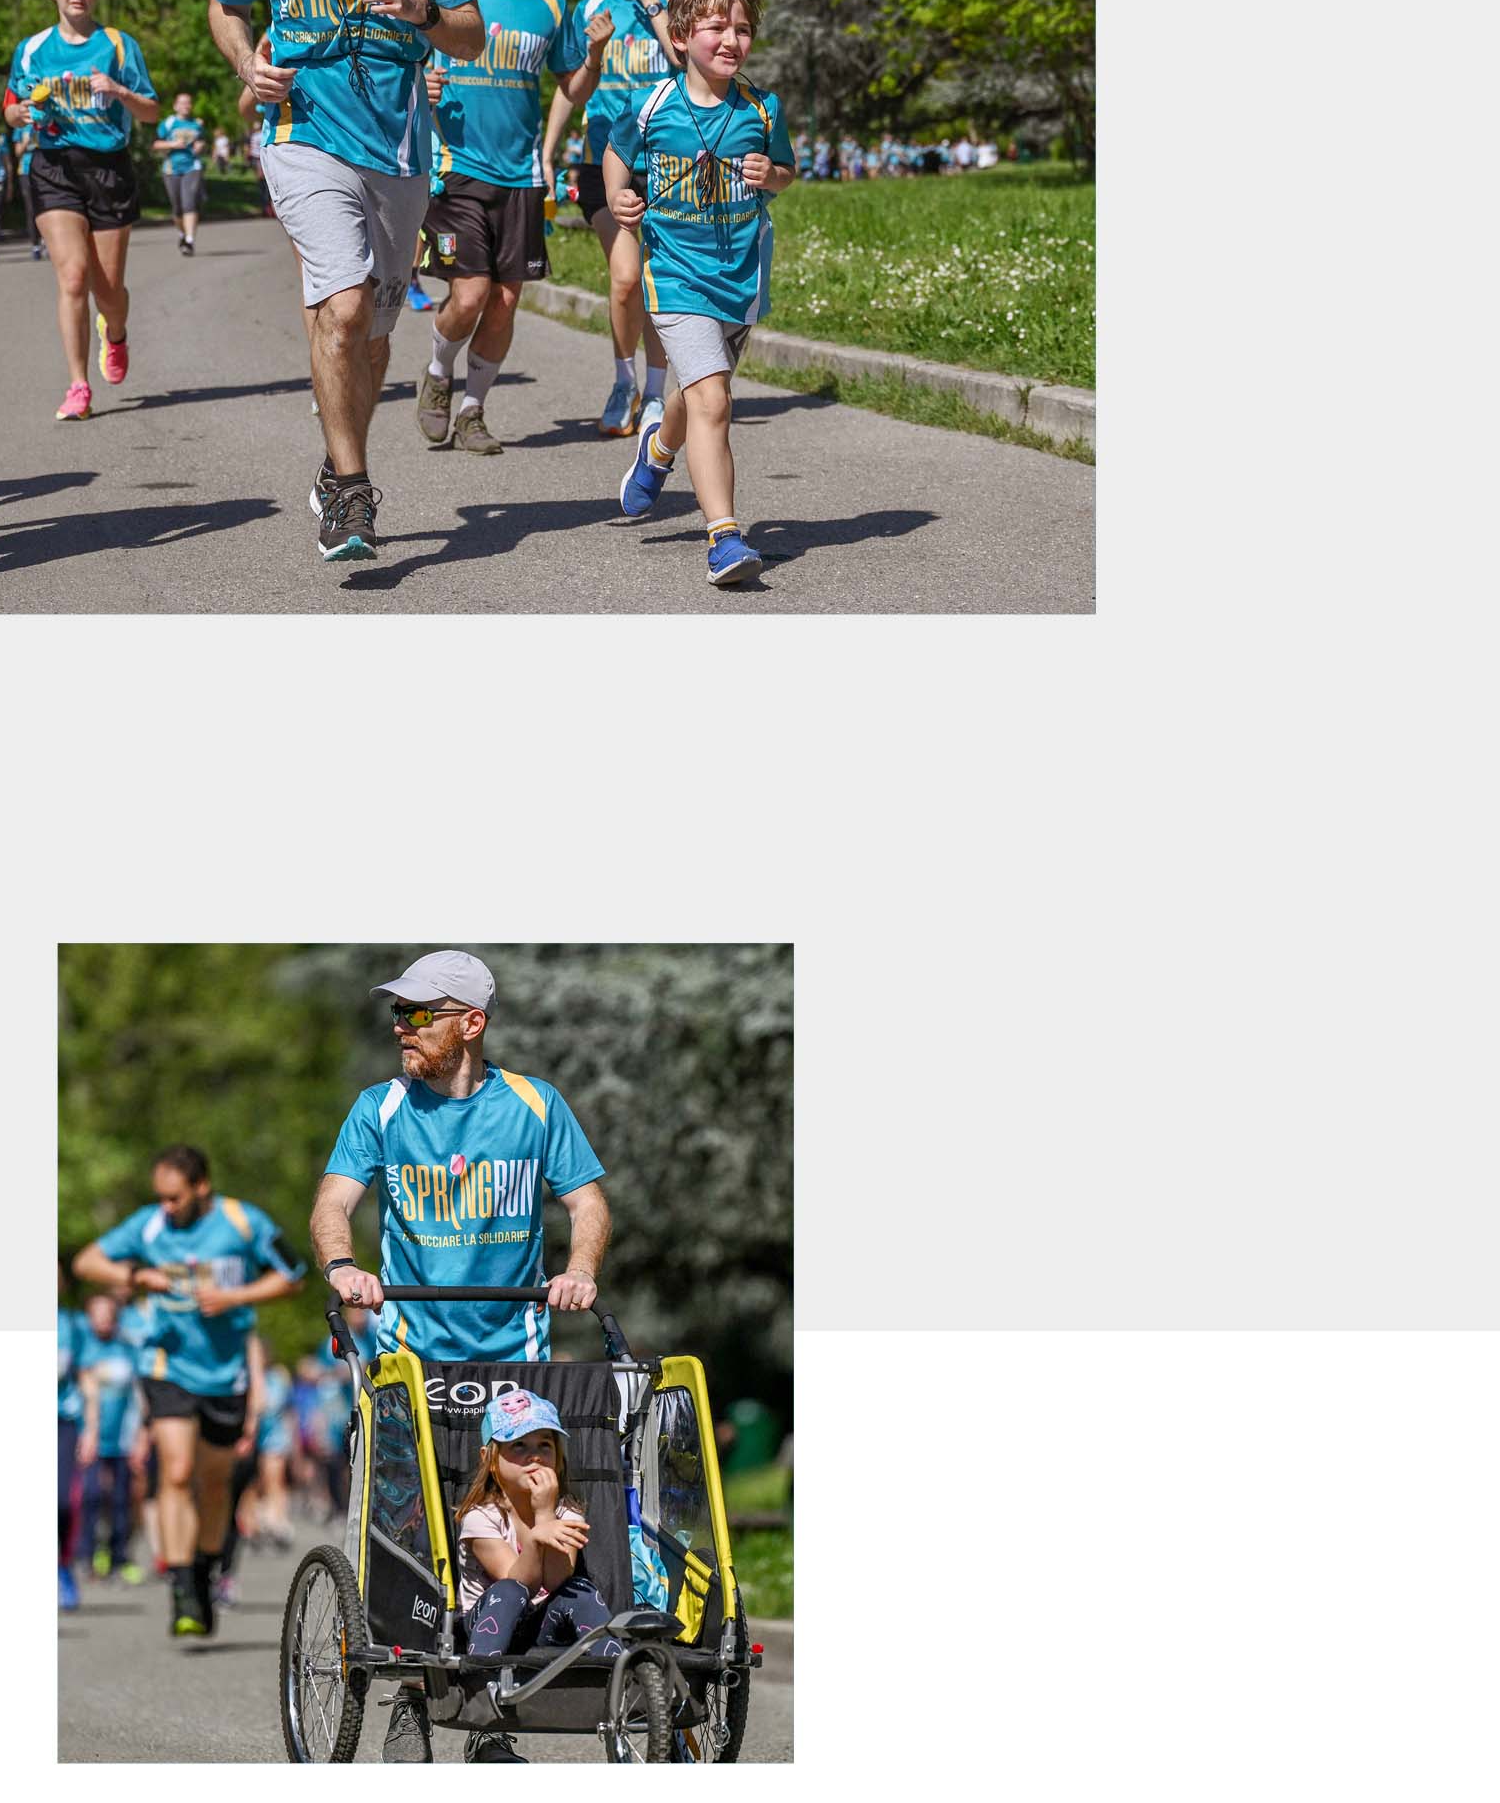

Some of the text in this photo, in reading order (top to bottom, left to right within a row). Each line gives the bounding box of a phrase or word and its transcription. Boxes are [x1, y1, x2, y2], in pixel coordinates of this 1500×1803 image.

[703, 213, 715, 224] LA
[463, 1233, 477, 1246] LA
[479, 1230, 531, 1245] SOLIDARIET
